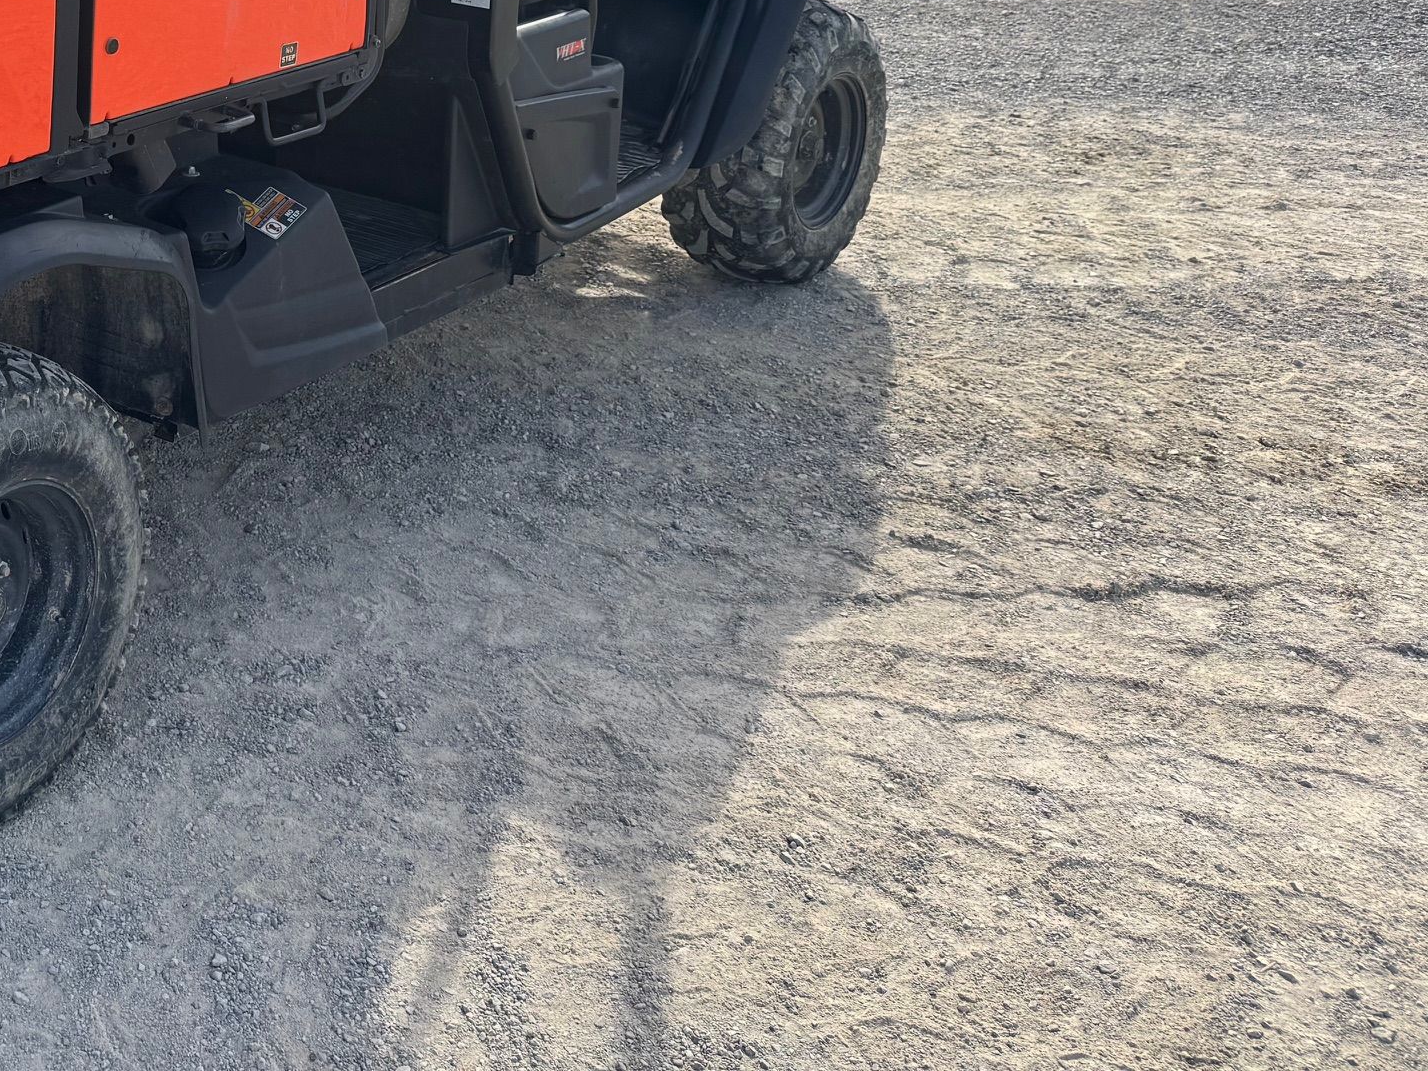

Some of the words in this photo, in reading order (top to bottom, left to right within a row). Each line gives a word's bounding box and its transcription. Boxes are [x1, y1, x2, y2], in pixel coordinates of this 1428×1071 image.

[285, 46, 294, 54] NO
[281, 53, 296, 63] STEP
[284, 209, 294, 218] NO
[287, 210, 300, 223] STEP
